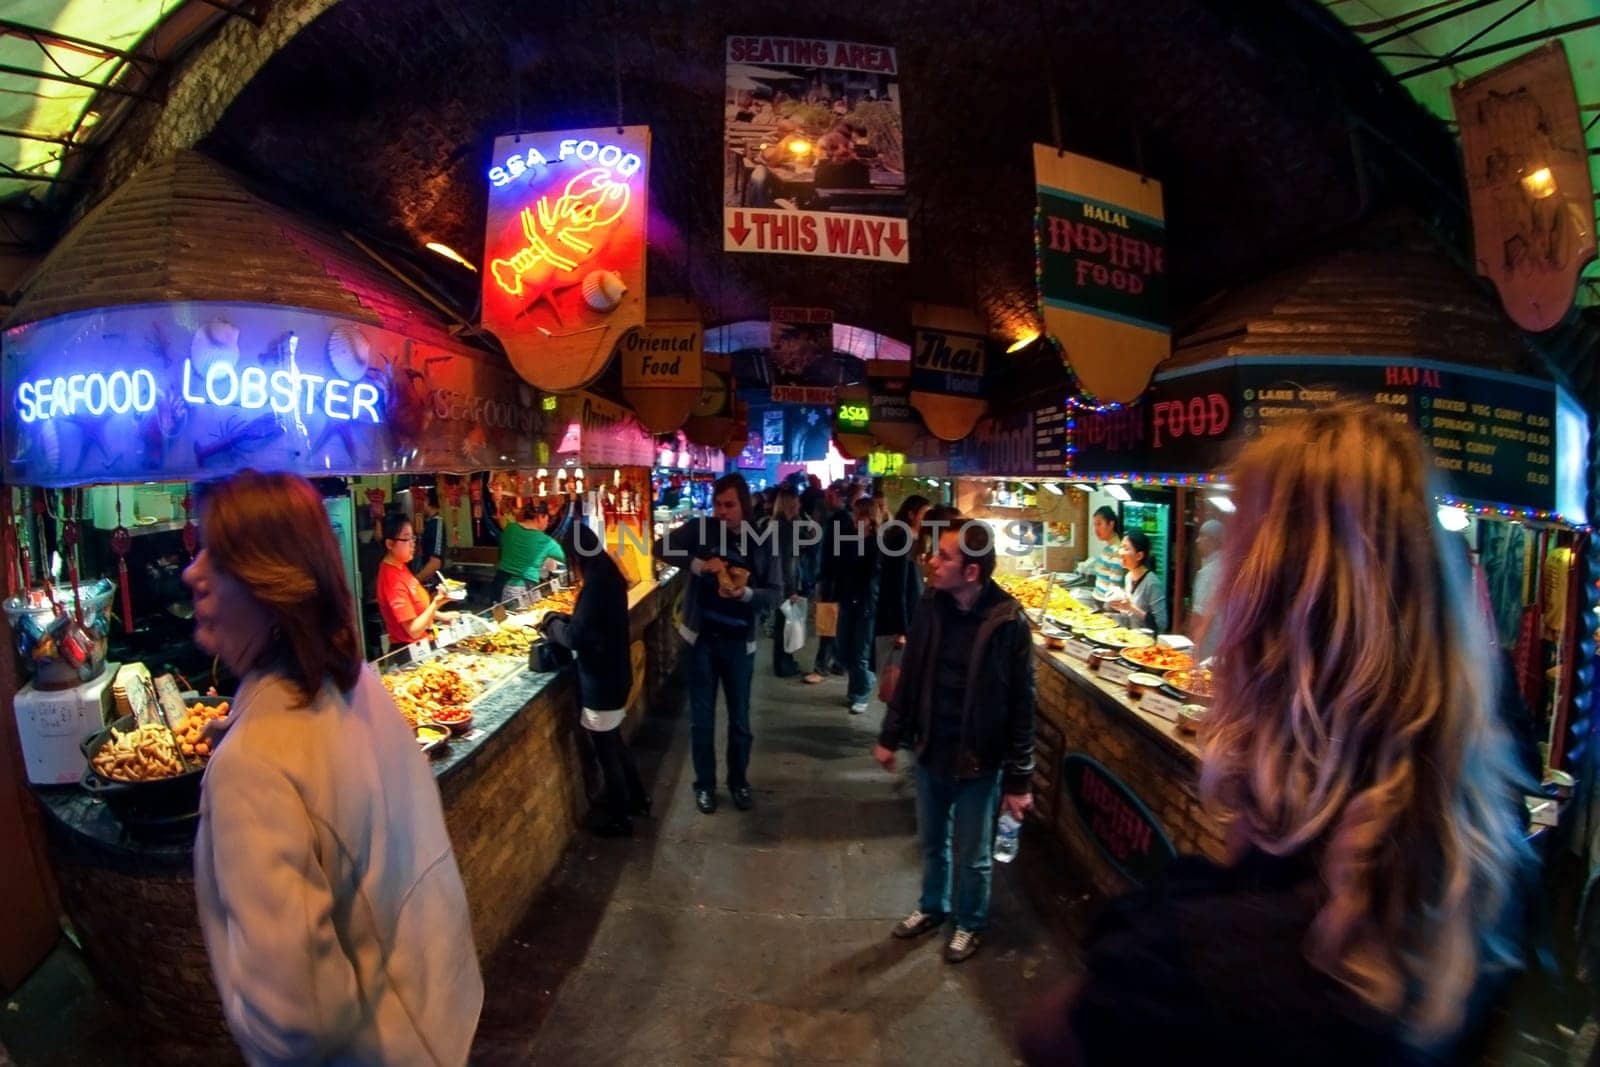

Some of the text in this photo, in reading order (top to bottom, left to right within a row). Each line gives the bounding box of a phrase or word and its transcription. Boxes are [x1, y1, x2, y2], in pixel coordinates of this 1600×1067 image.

[730, 37, 894, 73] SEATING AREA
[488, 140, 640, 187] SEA FOOD
[751, 213, 886, 257] THIS WAY
[1083, 203, 1129, 229] HALAL
[1047, 215, 1163, 274] INDIAN
[1076, 259, 1144, 294] FOOD
[626, 332, 696, 352] Oriental
[917, 334, 981, 374] Thai
[641, 356, 681, 377] Food
[19, 357, 380, 424] SEAFOOD LOBSTER
[1153, 393, 1230, 448] FOOD
